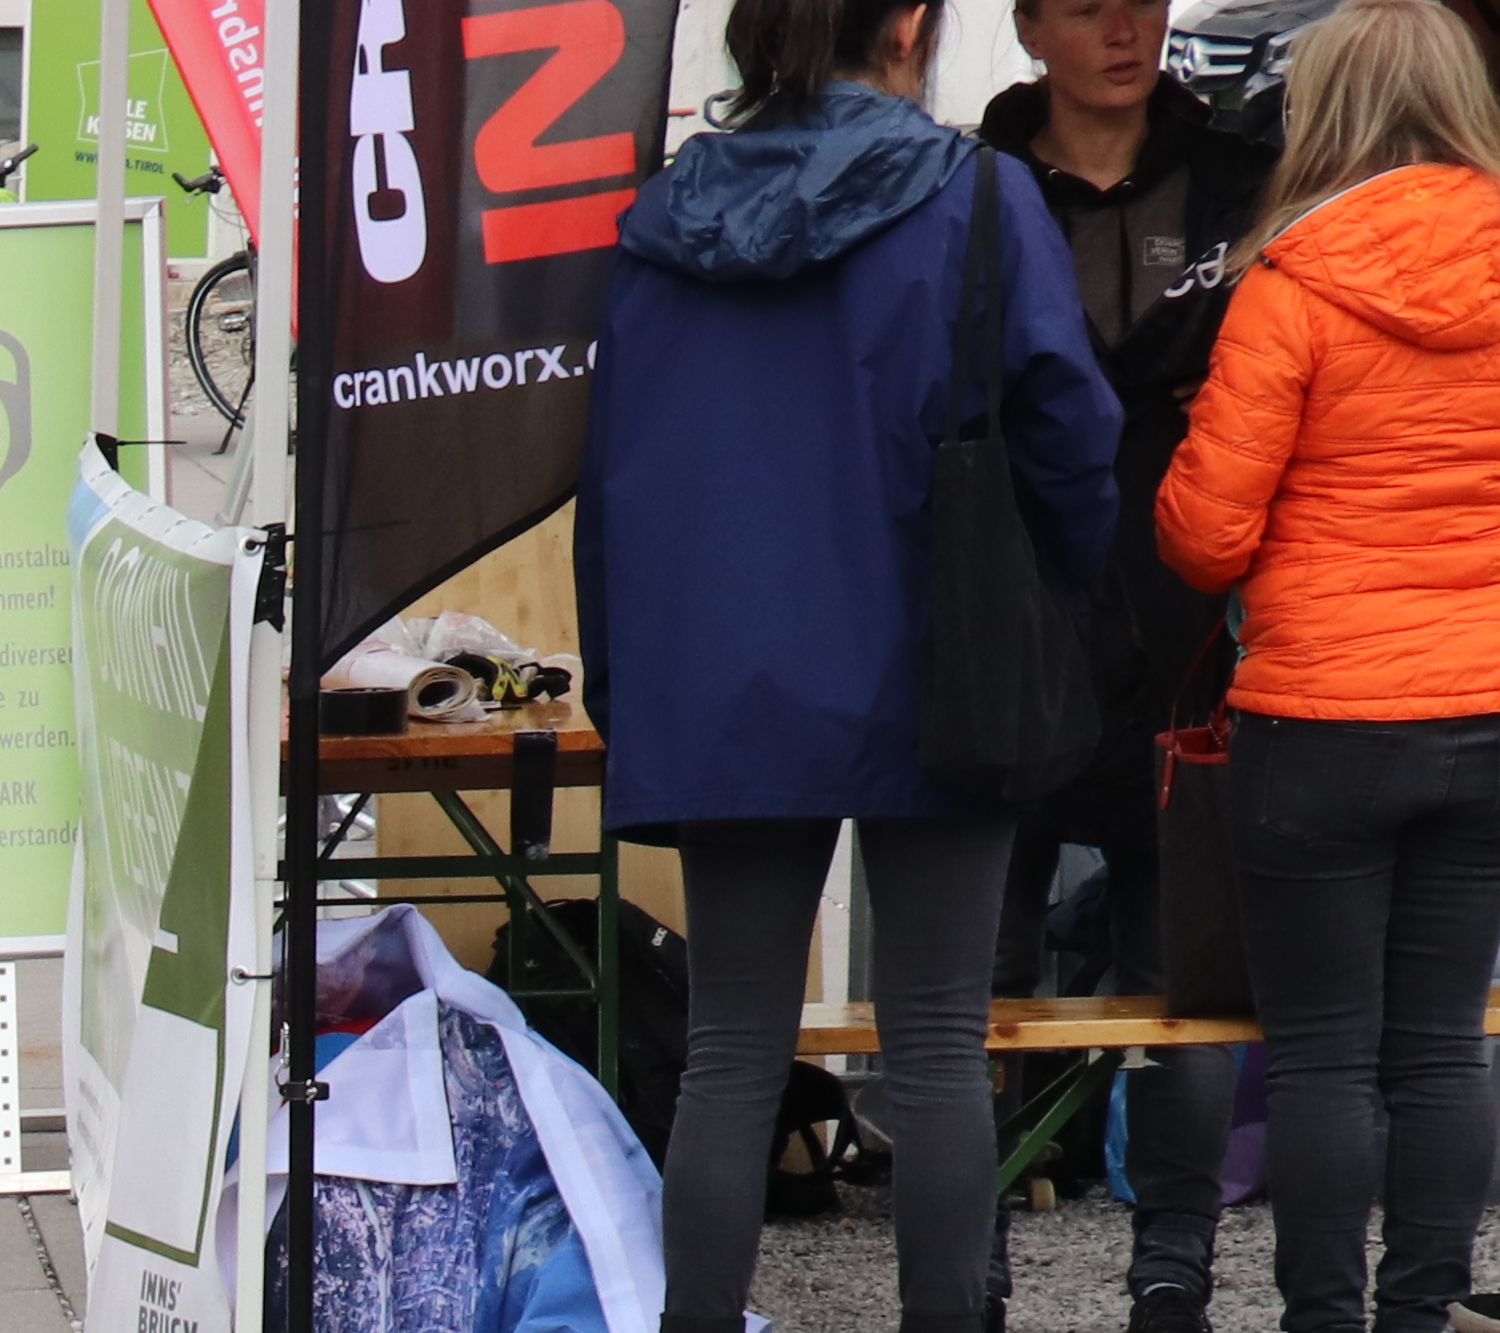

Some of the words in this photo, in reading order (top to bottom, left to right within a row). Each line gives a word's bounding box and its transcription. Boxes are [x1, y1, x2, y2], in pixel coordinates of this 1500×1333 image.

[461, 0, 637, 264] IN
[0, 642, 72, 666] diverse
[18, 690, 40, 707] zu
[0, 724, 75, 749] werden.
[140, 1269, 182, 1311] INNS'
